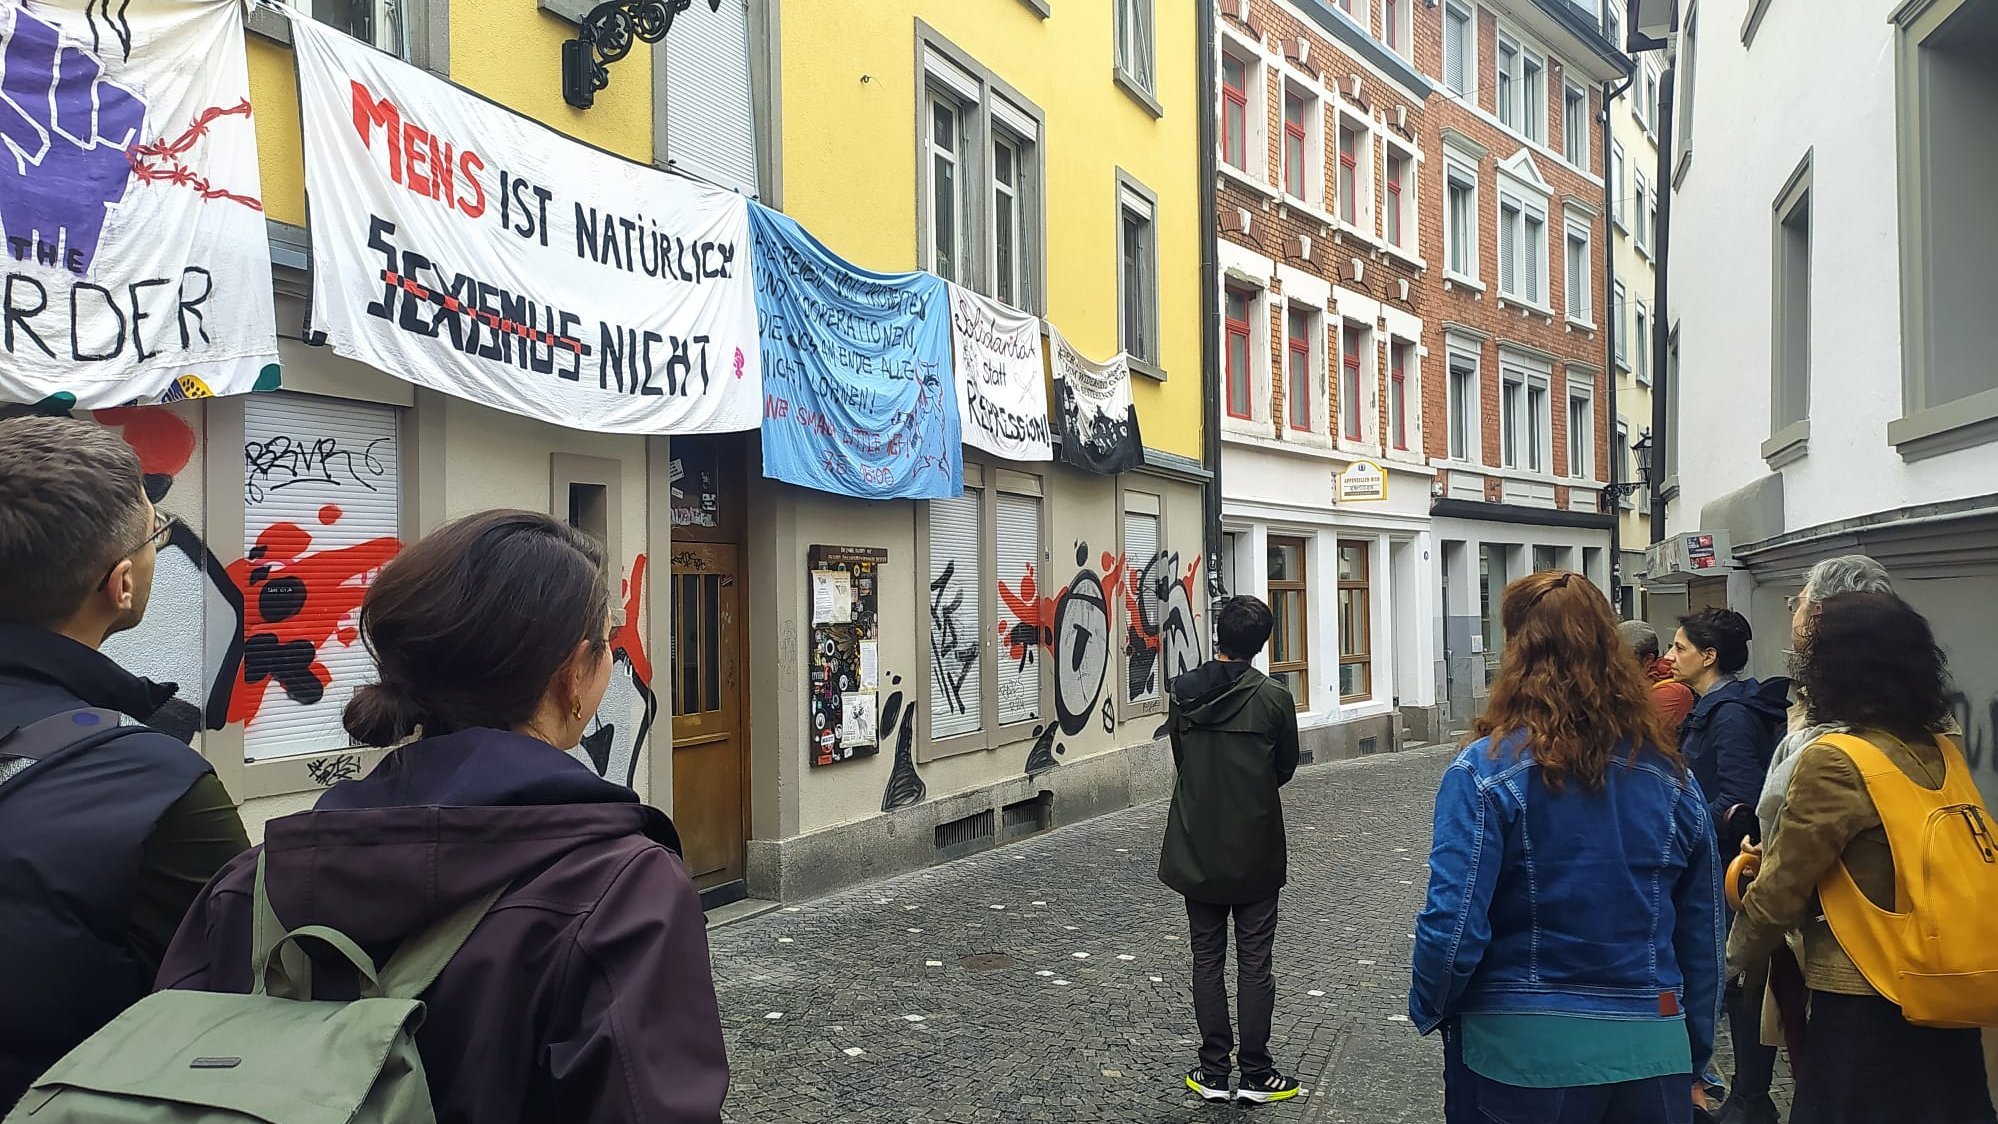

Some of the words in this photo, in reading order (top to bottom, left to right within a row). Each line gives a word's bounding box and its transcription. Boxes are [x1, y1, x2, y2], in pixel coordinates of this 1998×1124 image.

[351, 79, 486, 219] MENS
[500, 170, 553, 247] IST
[574, 201, 734, 284] NATÜRLICH
[9, 236, 85, 274] THE
[366, 213, 584, 383] SEXISMUS
[599, 320, 711, 397] NICHT
[758, 308, 785, 342] DIE
[838, 346, 874, 376] ENDE
[881, 355, 915, 381] ALLE
[761, 349, 806, 390] NICHT
